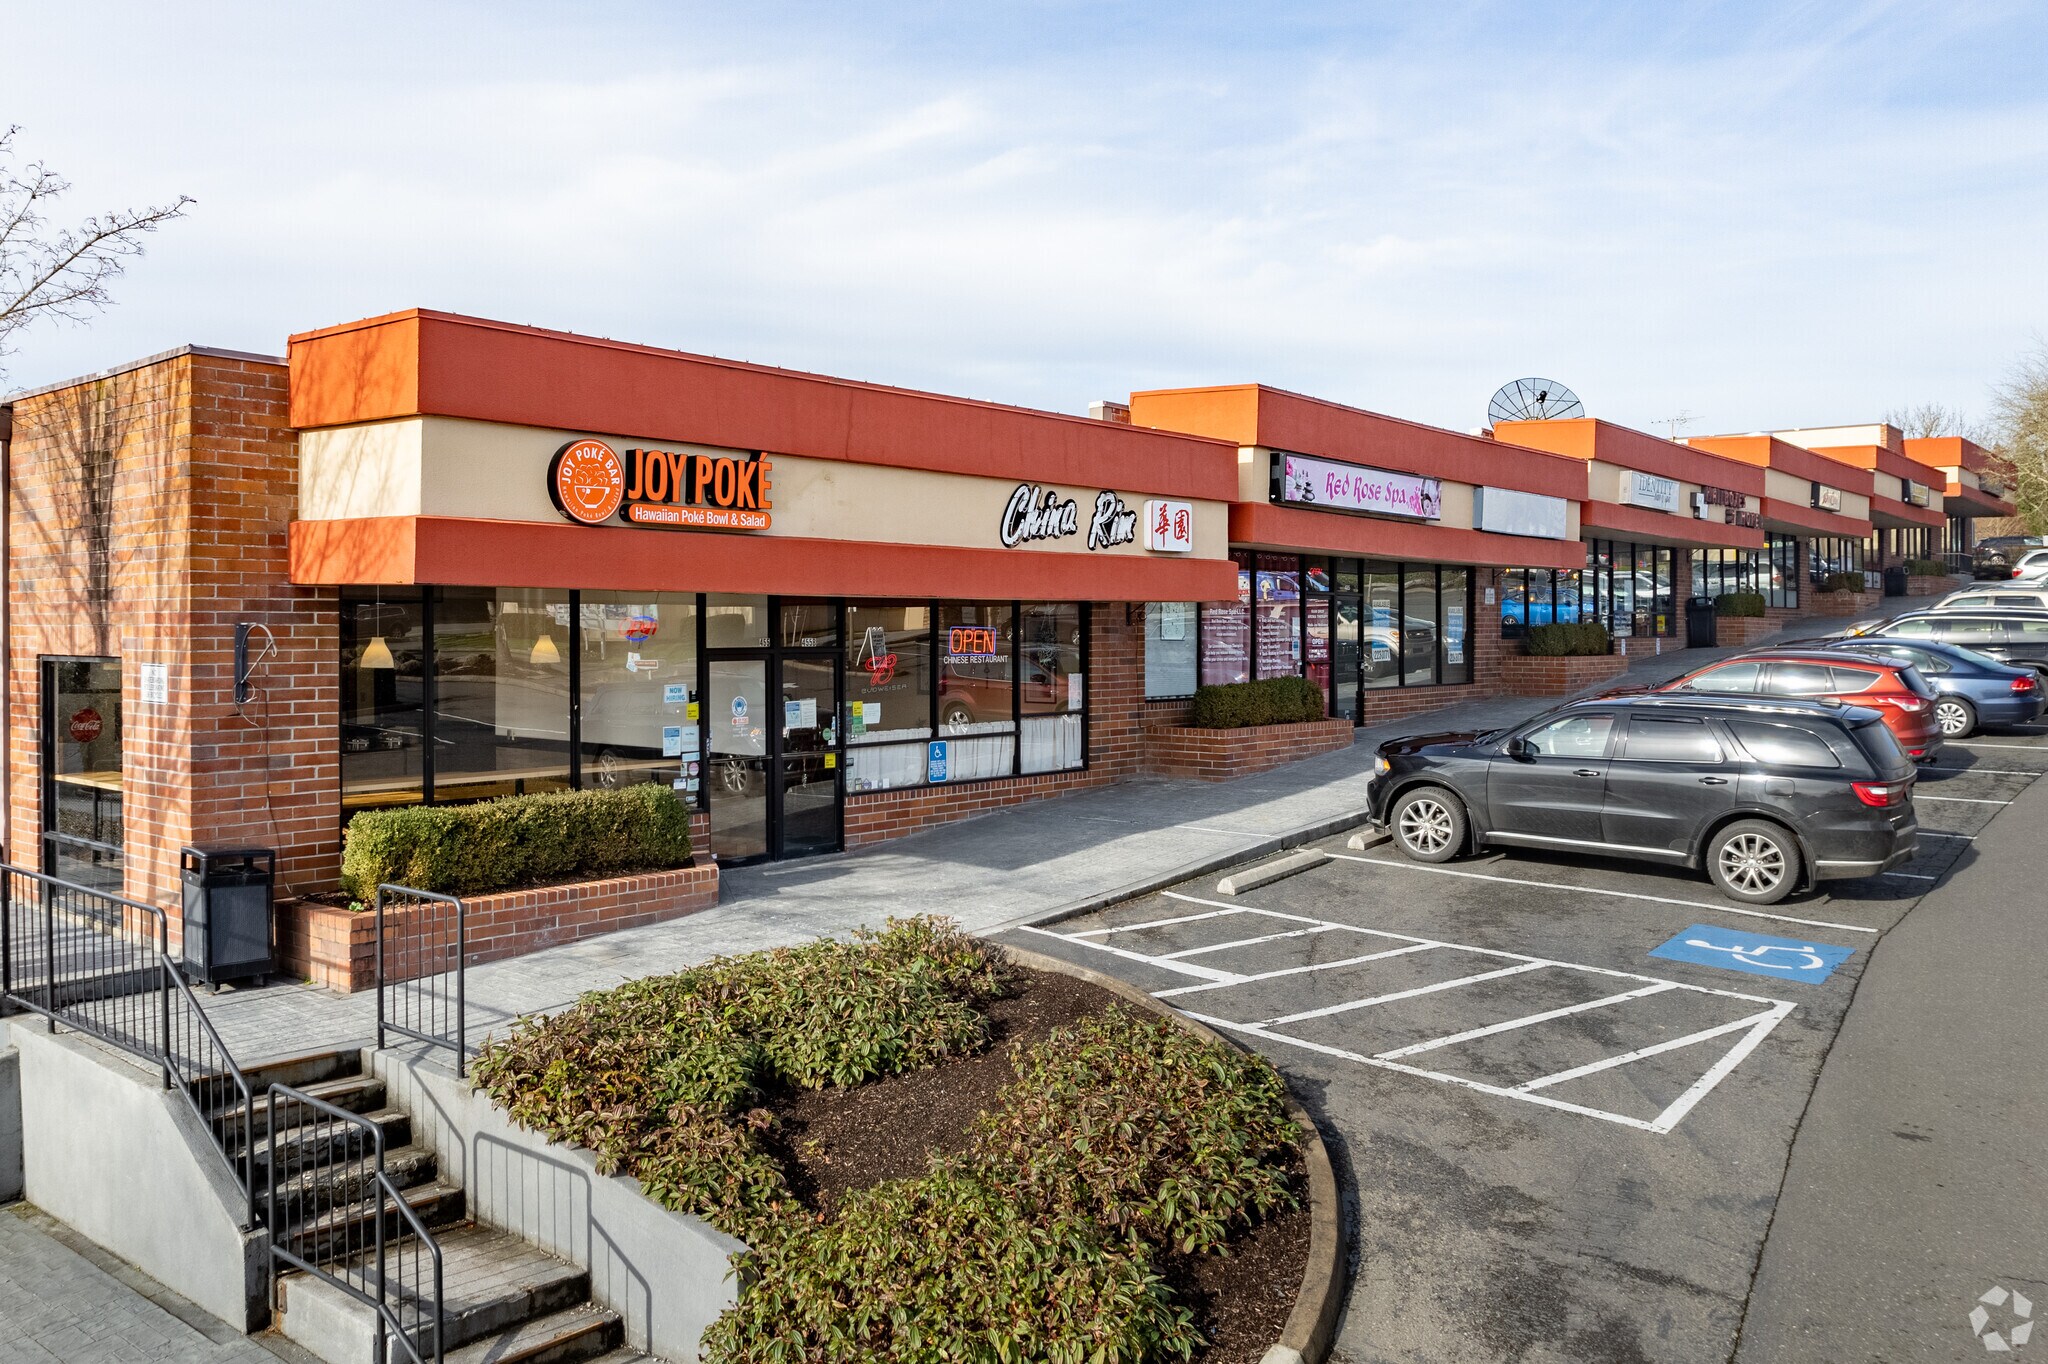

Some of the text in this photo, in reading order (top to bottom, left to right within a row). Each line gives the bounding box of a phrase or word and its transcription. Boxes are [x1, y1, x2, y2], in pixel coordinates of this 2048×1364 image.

[562, 447, 620, 485] JOY POKÉ BAR
[627, 448, 772, 509] JOY POKÉ
[1639, 475, 1674, 496] IDENTITY
[1326, 471, 1406, 509] Red Rose Spa
[635, 507, 765, 527] Hawaiian Poké Bowl & Salad
[1001, 483, 1078, 549] China
[760, 638, 770, 647] 455
[951, 629, 995, 653] OPEN
[943, 655, 1008, 664] CHINESE RESTAURANT
[861, 684, 907, 694] BUDWEISER
